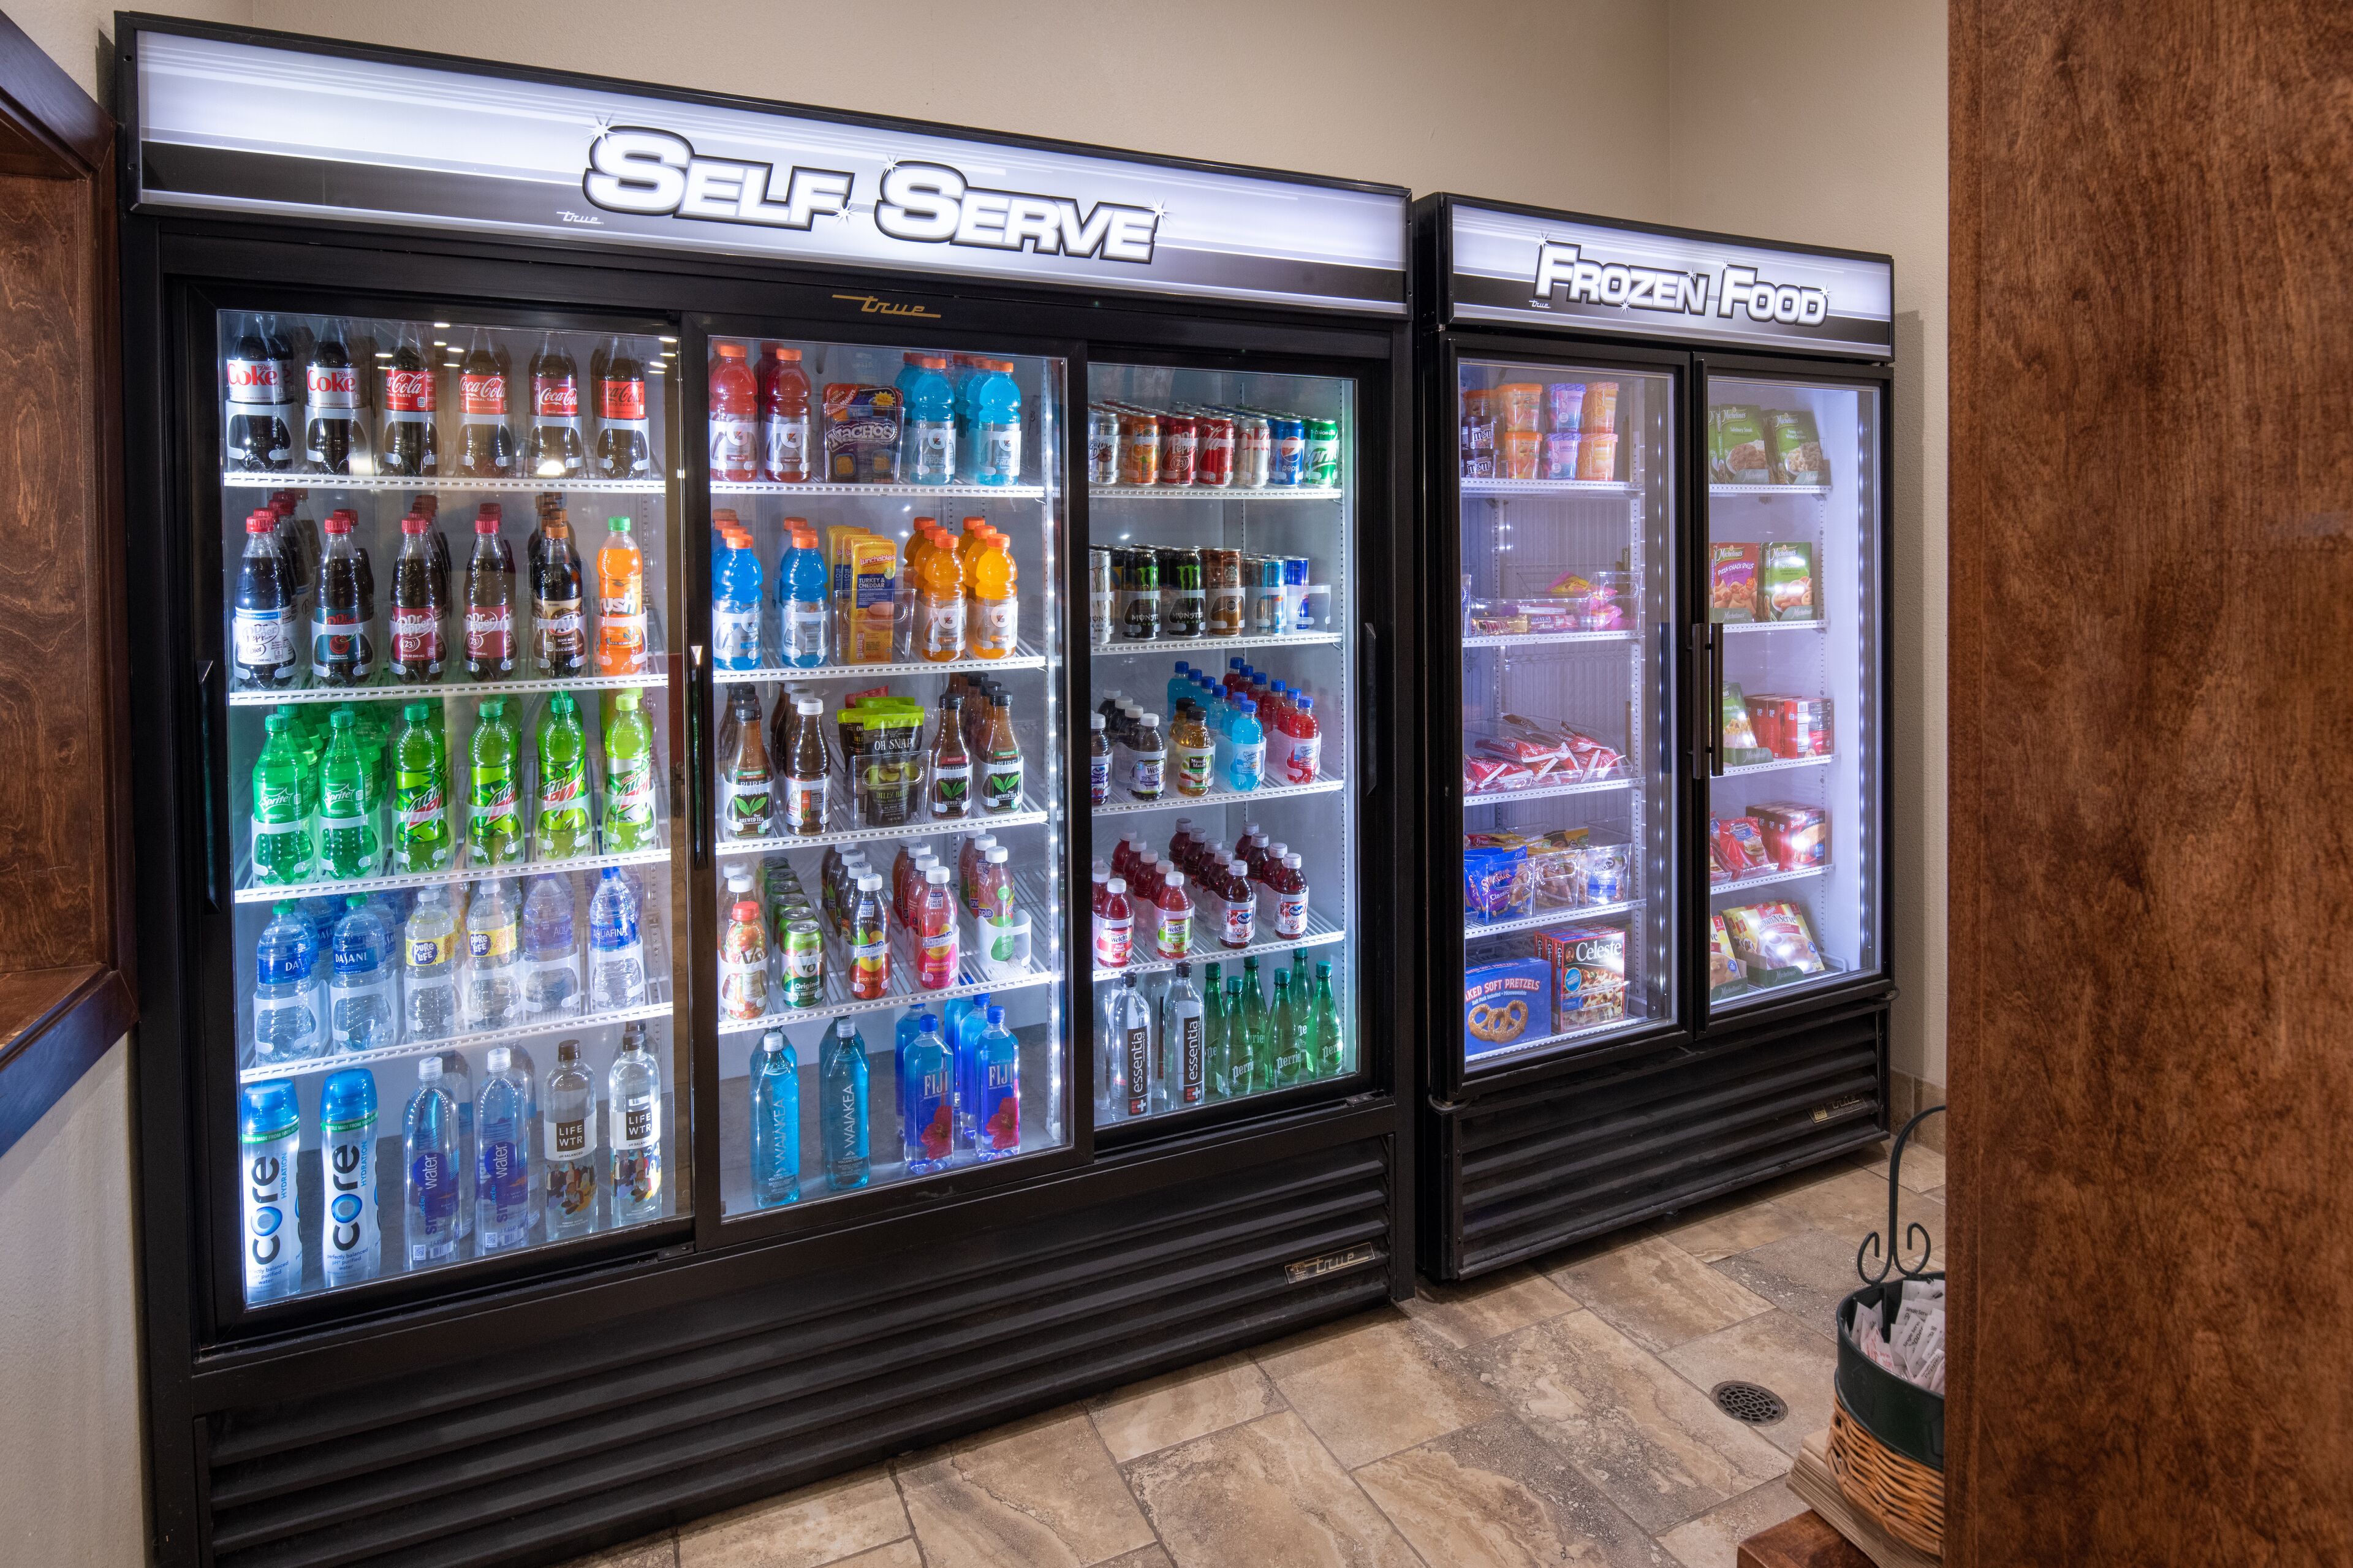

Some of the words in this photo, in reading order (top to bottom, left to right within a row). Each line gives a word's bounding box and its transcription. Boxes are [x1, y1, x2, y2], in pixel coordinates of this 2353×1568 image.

[583, 126, 855, 230] SELF
[874, 161, 1158, 263] SERVE
[556, 210, 603, 224] true
[1534, 241, 1709, 316] FROZEN
[1717, 265, 1828, 327] FOOD
[833, 294, 941, 318] true
[227, 363, 278, 385] Coke
[307, 370, 356, 392] Coke
[460, 377, 506, 398] Coca-Cola
[1722, 410, 1746, 422] Michelina's
[860, 555, 895, 566] Lunchables
[1716, 548, 1743, 561] Michelina's
[1770, 548, 1796, 561] Michelina's
[1718, 567, 1729, 576] PIZZA
[407, 615, 422, 624] Dr
[472, 613, 485, 622] Dr
[1132, 613, 1159, 622] MONST
[396, 618, 433, 637] Pepper
[874, 741, 885, 750] OH
[621, 771, 637, 785] diet
[262, 795, 289, 807] Sprite
[325, 791, 350, 801] Sprite
[1490, 890, 1510, 901] Classic
[1779, 915, 1796, 923] Serve
[593, 928, 627, 941] AQUAFINA
[1111, 934, 1127, 943] Welch's
[1576, 939, 1622, 963] Celeste
[335, 952, 367, 965] DASANI
[1466, 988, 1482, 1002] AKED
[1485, 979, 1502, 994] SOFT
[1504, 977, 1540, 991] PRETZELS
[1189, 1021, 1198, 1080] essentia
[1134, 1031, 1143, 1093] essentia
[1276, 1051, 1301, 1074] perrie
[988, 1063, 1014, 1087] FIJI
[924, 1070, 948, 1096] FIJI
[628, 1112, 651, 1125] LIFE
[559, 1125, 583, 1136] LIFE
[628, 1124, 651, 1135] WTR
[559, 1135, 583, 1146] WTR
[331, 1145, 363, 1251] core
[251, 1156, 283, 1265] core
[347, 1248, 368, 1259] balanced
[265, 1260, 289, 1271] balanced
[261, 1269, 282, 1280] purified
